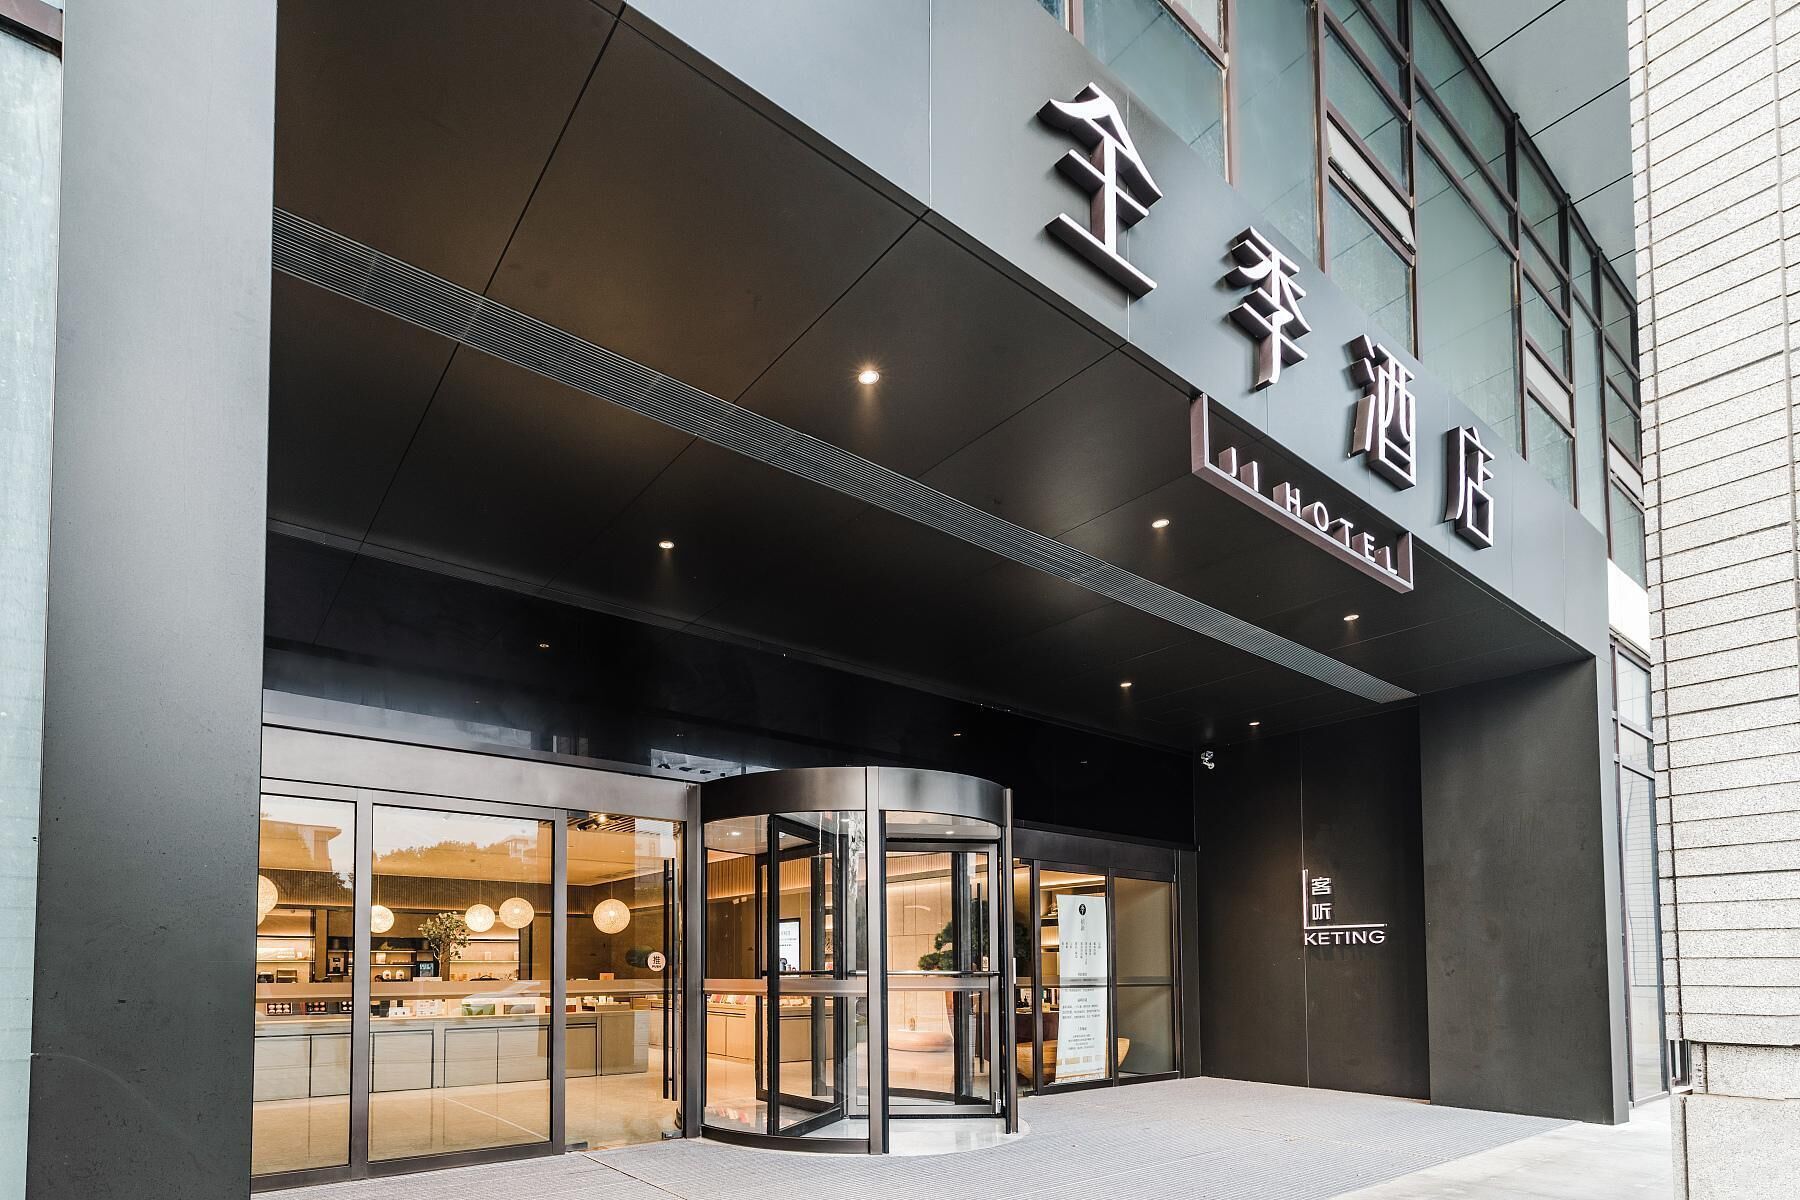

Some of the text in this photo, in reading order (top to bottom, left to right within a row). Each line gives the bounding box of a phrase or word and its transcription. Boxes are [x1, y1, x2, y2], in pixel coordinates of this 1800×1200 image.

[1040, 82, 1495, 549] 全季酒店
[1223, 446, 1398, 575] JI HOTEL
[1311, 876, 1332, 920] 客听
[652, 955, 661, 965] 推
[1304, 930, 1386, 946] KETING
